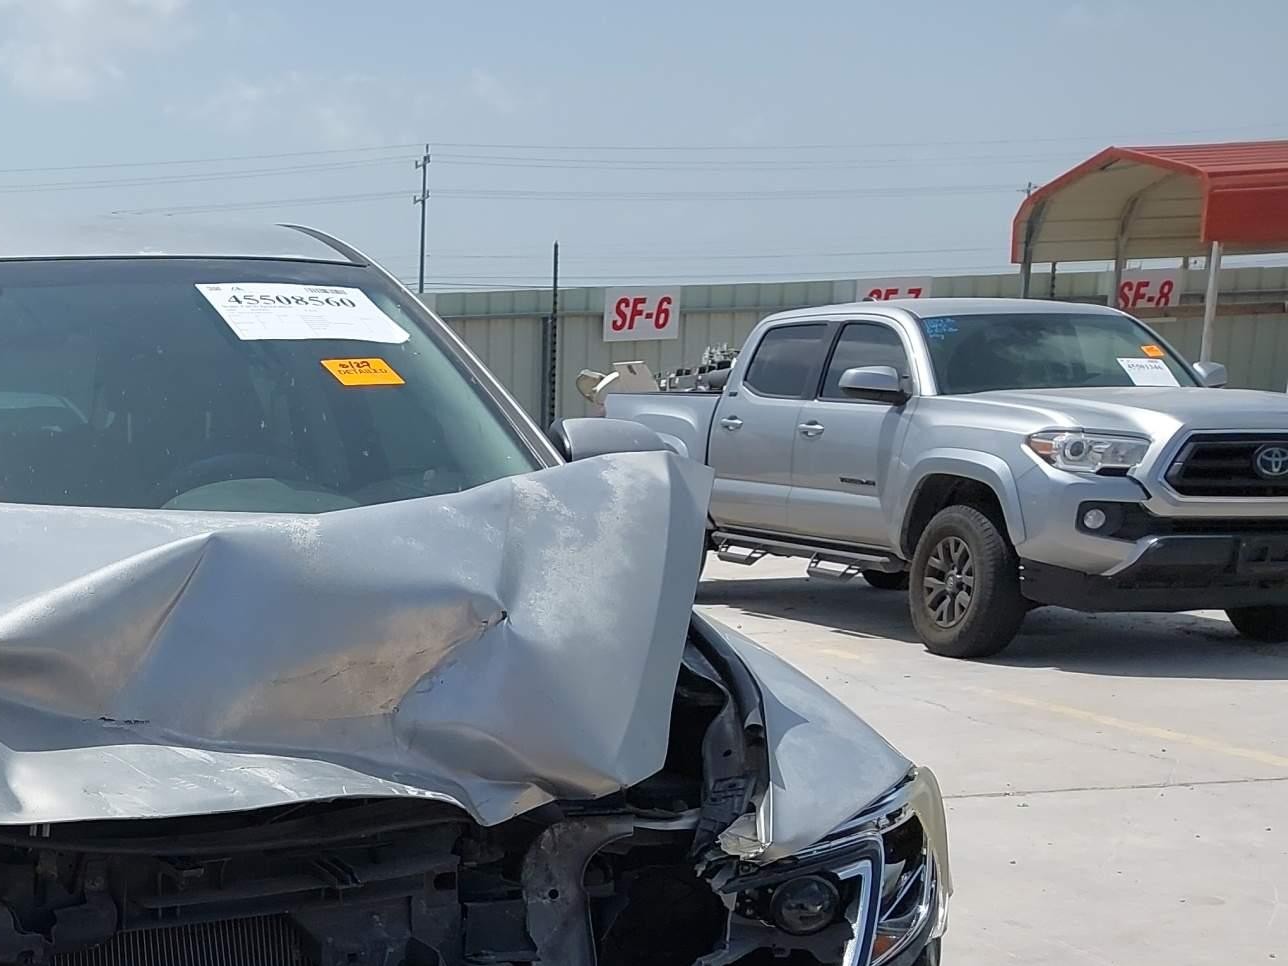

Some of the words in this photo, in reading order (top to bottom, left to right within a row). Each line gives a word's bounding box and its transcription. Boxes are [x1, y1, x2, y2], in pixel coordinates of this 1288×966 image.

[228, 294, 356, 308] 45508560
[1120, 280, 1173, 307] SF-8
[612, 296, 672, 331] SF-6
